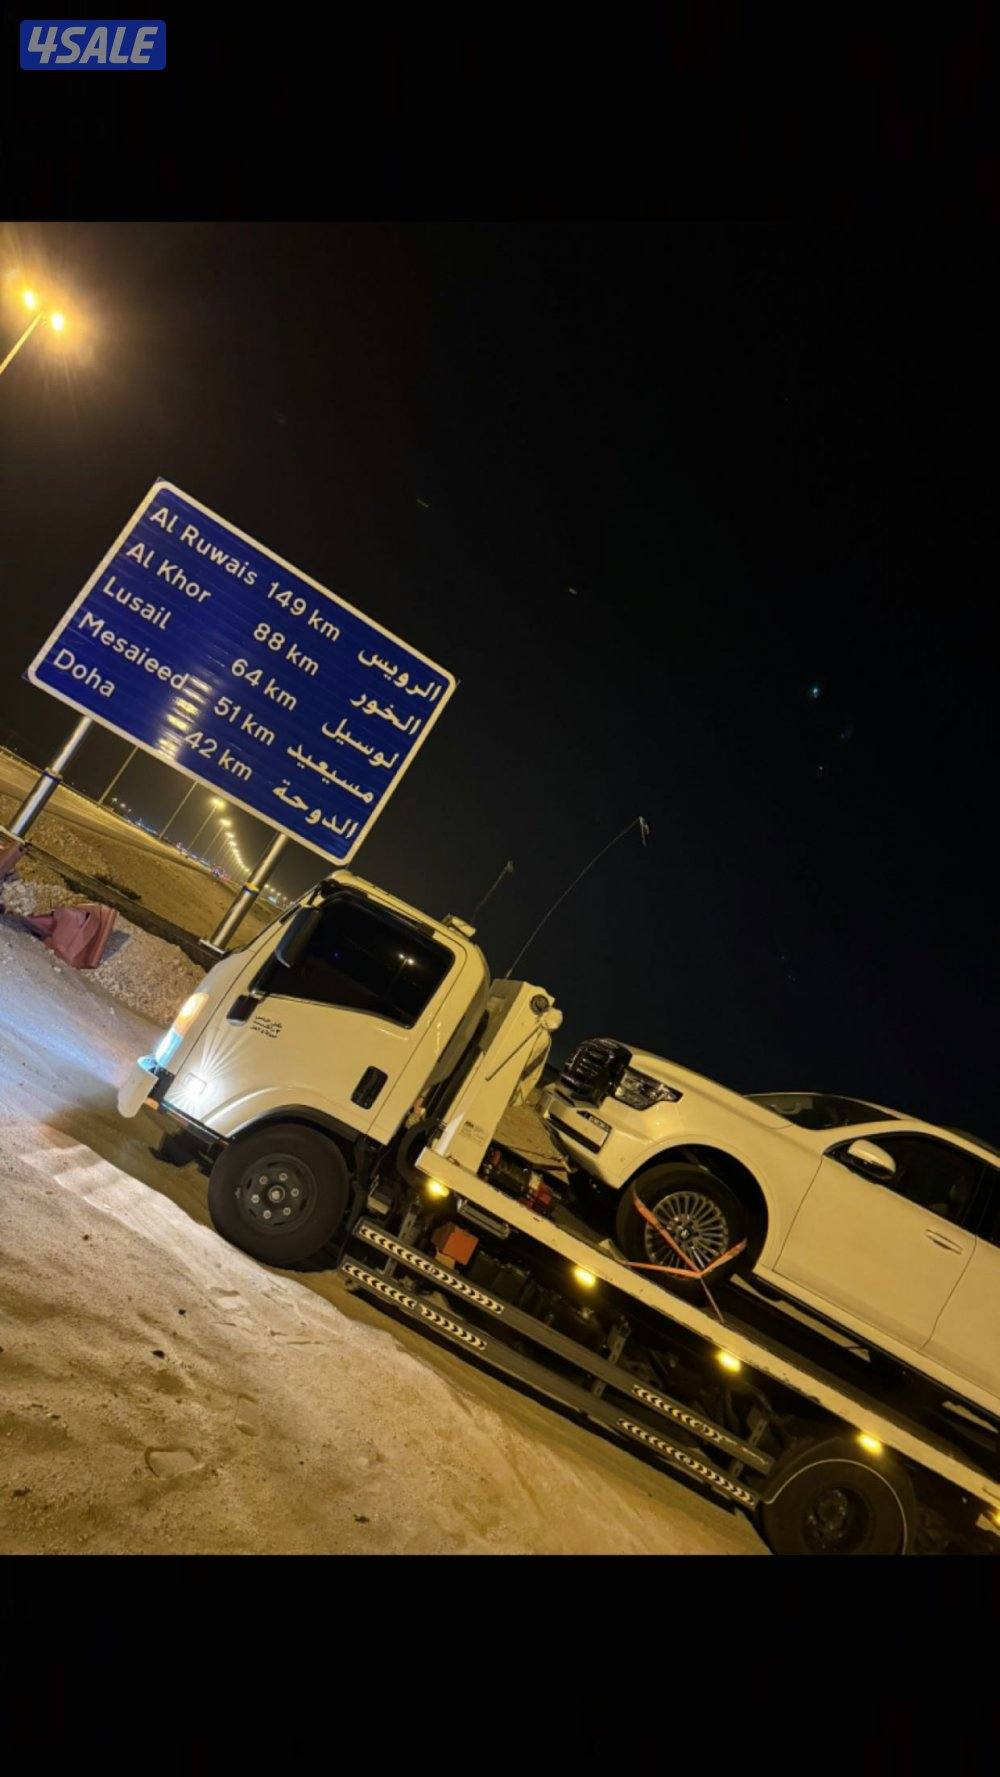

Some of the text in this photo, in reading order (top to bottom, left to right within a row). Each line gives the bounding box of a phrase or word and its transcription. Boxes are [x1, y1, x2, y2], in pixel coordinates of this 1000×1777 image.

[125, 542, 319, 676] Al Khor 88 km
[149, 507, 340, 642] Al Ruwais 149 km
[78, 611, 275, 746] Mesaieed 51 km
[102, 575, 297, 710] Lusail 64 km
[357, 649, 443, 702] الرويس
[53, 648, 252, 781] Doha 42 km
[321, 718, 399, 769] لوسيل
[350, 693, 422, 735] الخور
[272, 779, 359, 839] الدوحة
[287, 744, 374, 804] مسيعيد
